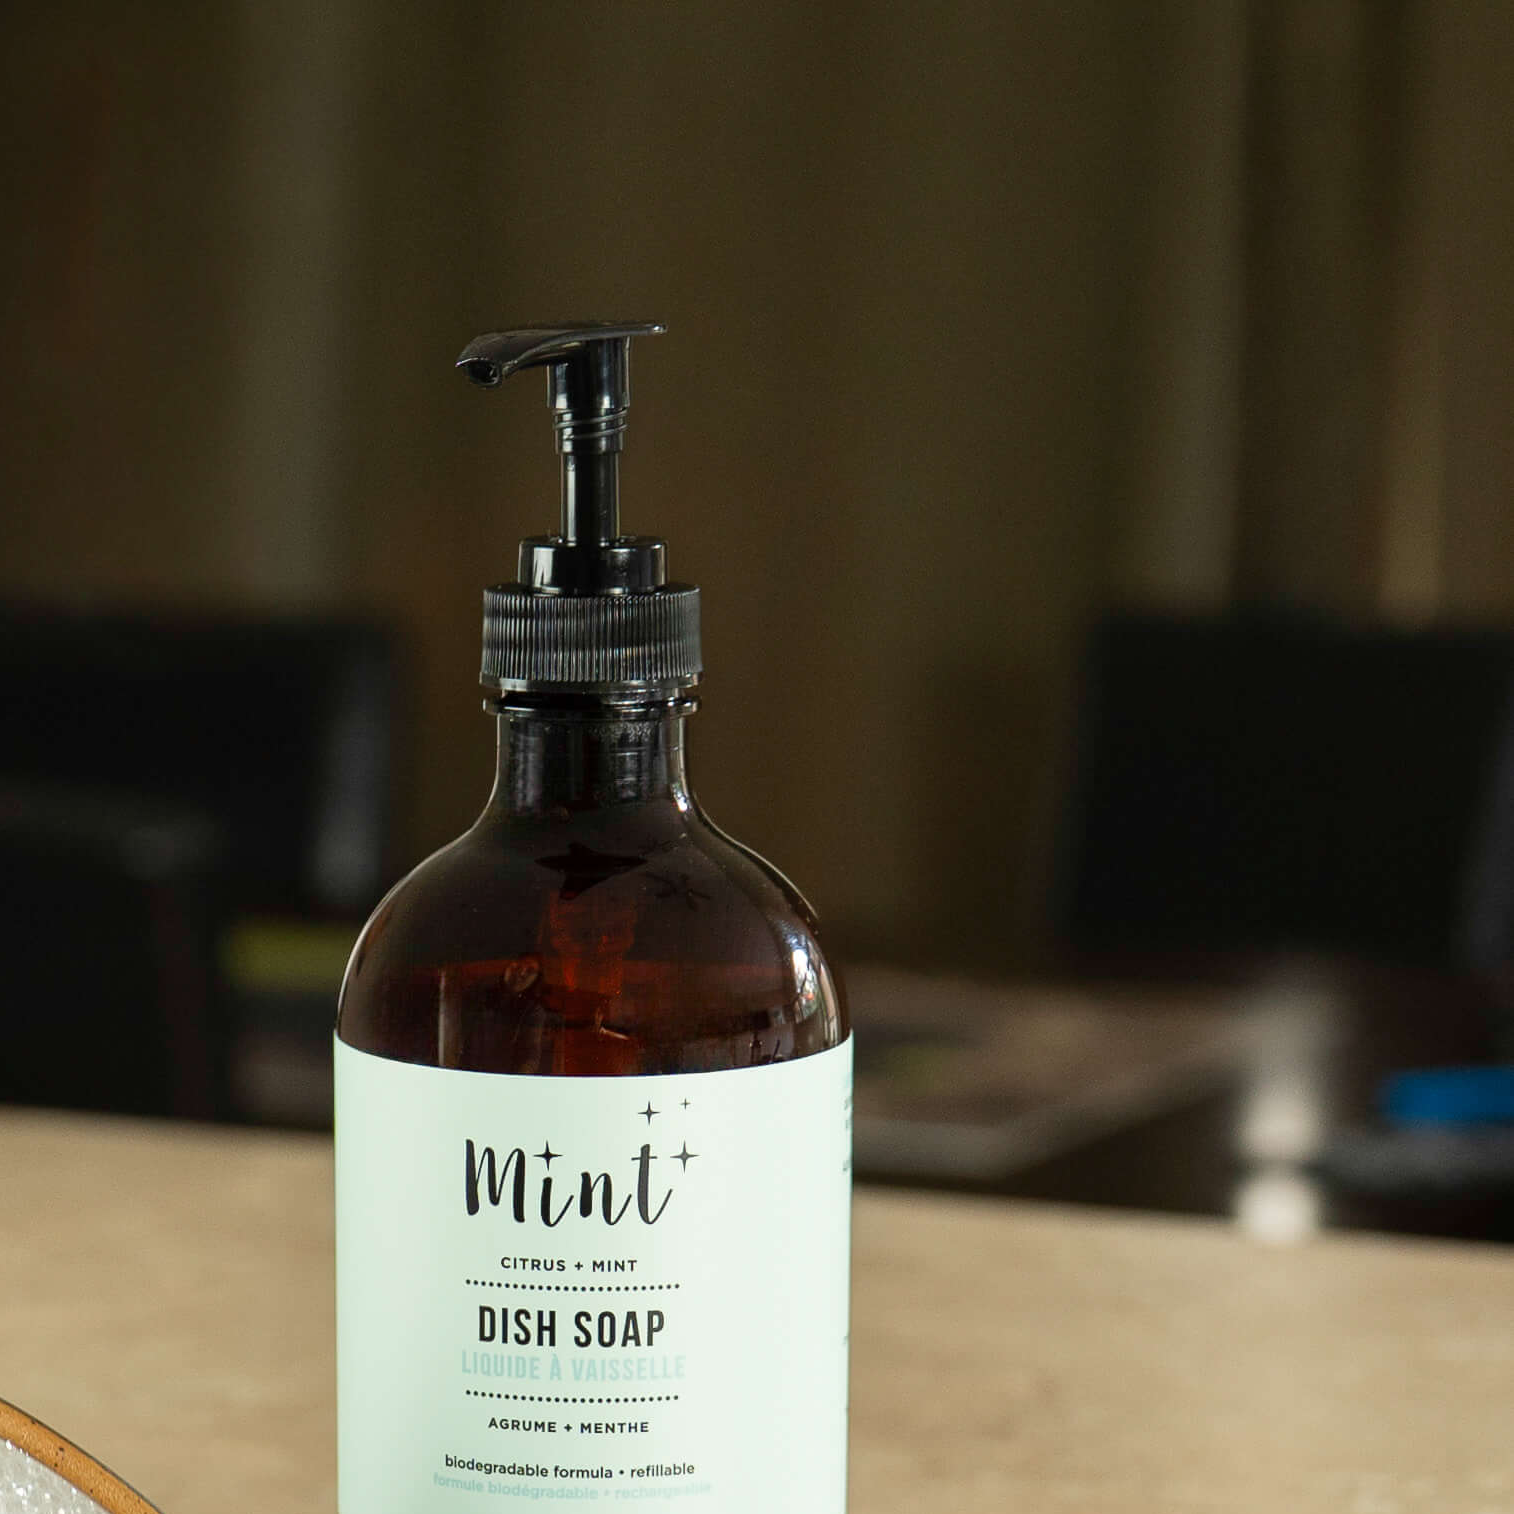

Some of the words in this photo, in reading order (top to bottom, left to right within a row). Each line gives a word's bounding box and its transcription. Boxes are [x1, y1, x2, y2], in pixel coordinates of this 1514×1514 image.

[465, 1138, 673, 1228] Mint
[500, 1256, 567, 1273] CITRUS
[573, 1260, 584, 1272] +
[591, 1259, 639, 1273] MINT
[478, 1304, 557, 1348] DISH
[573, 1309, 666, 1349] SOAP
[461, 1349, 542, 1381] LIQUIDE
[549, 1353, 563, 1382] À
[570, 1355, 687, 1383] VAISSELLE
[487, 1416, 558, 1433] AGRUME
[563, 1423, 574, 1433] +
[579, 1421, 650, 1435] MENTHE
[445, 1453, 549, 1478] biodegradable
[553, 1464, 614, 1479] formula
[630, 1462, 695, 1479] refillable
[432, 1472, 484, 1493] formule
